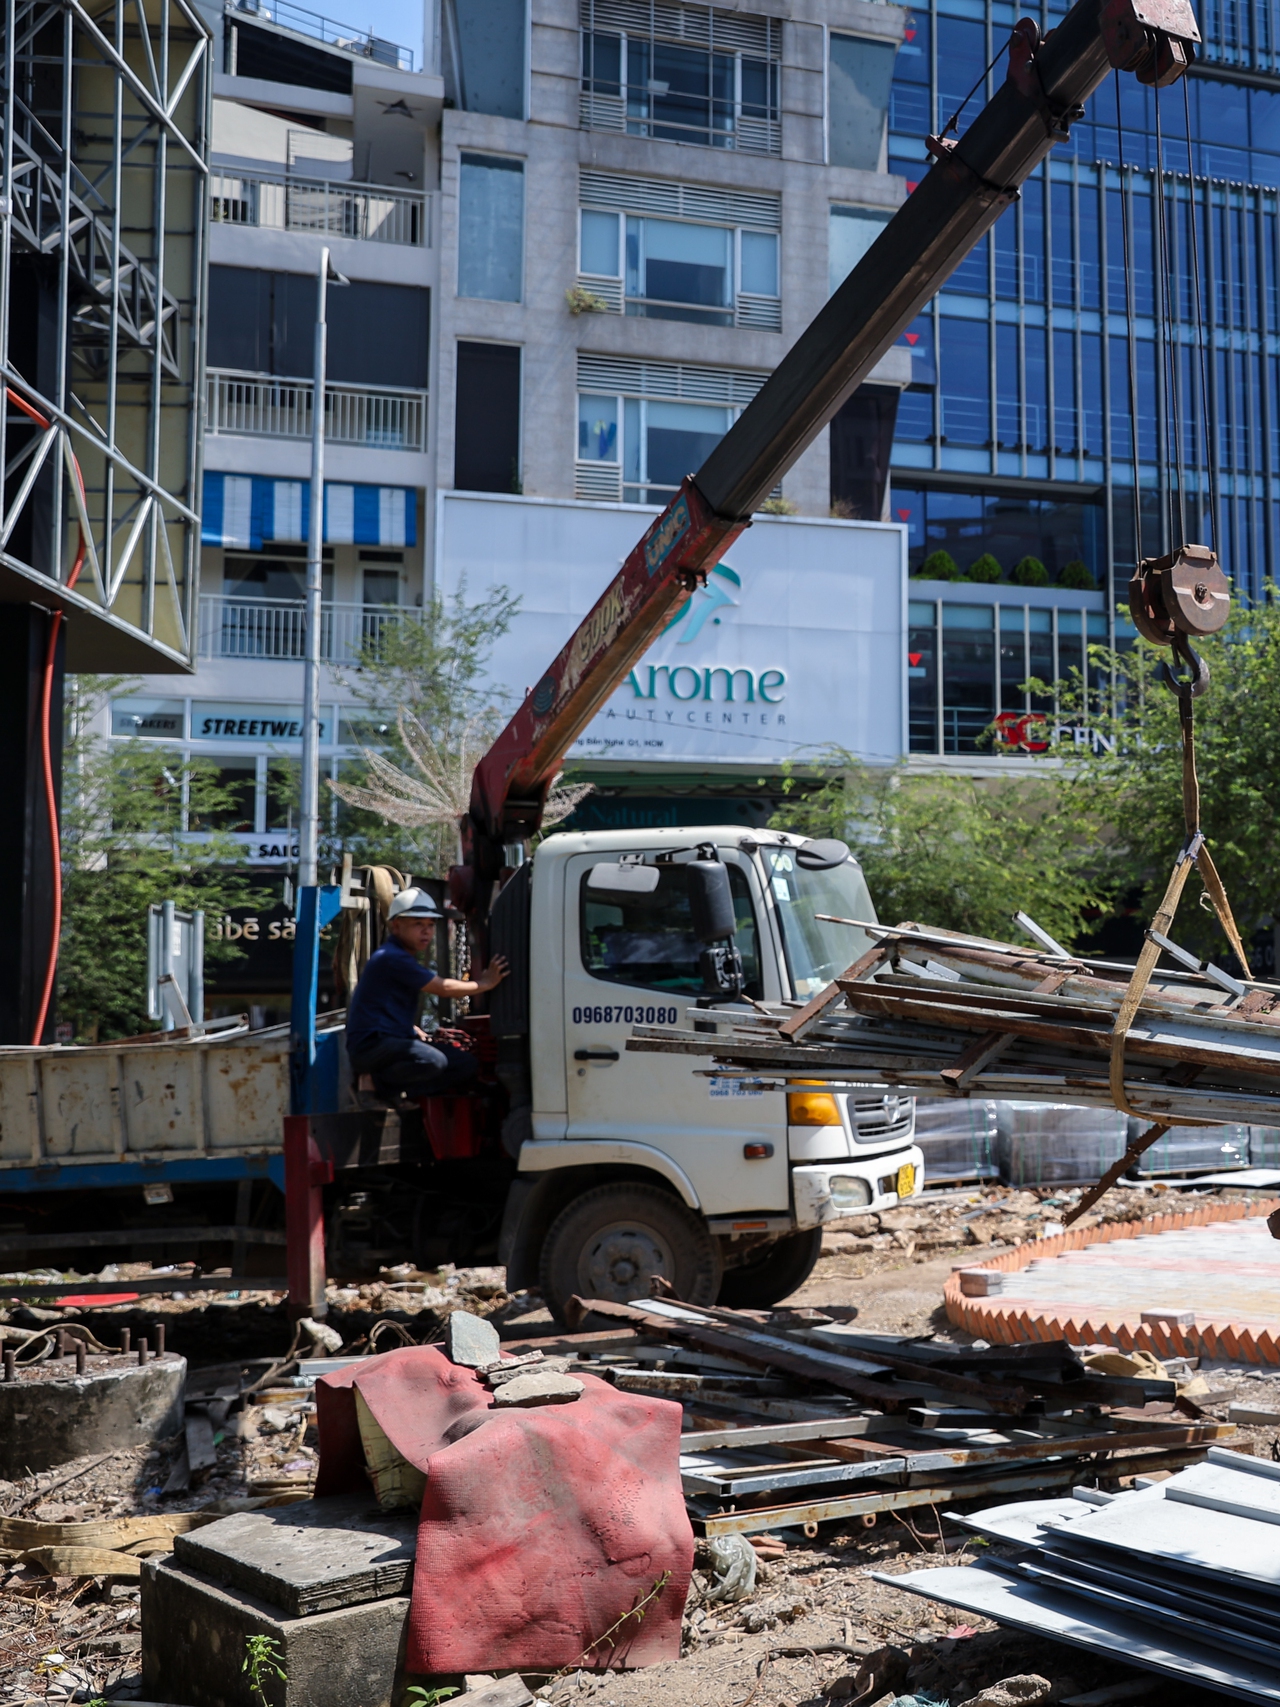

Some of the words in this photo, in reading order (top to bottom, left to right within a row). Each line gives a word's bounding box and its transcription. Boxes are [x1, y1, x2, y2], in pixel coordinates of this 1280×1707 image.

[606, 708, 674, 722] AUTY
[686, 711, 787, 725] CENTER
[202, 718, 325, 738] STREETWER
[993, 711, 1048, 751] SC
[259, 844, 331, 858] SAIGN
[572, 1006, 677, 1025] 0968703080
